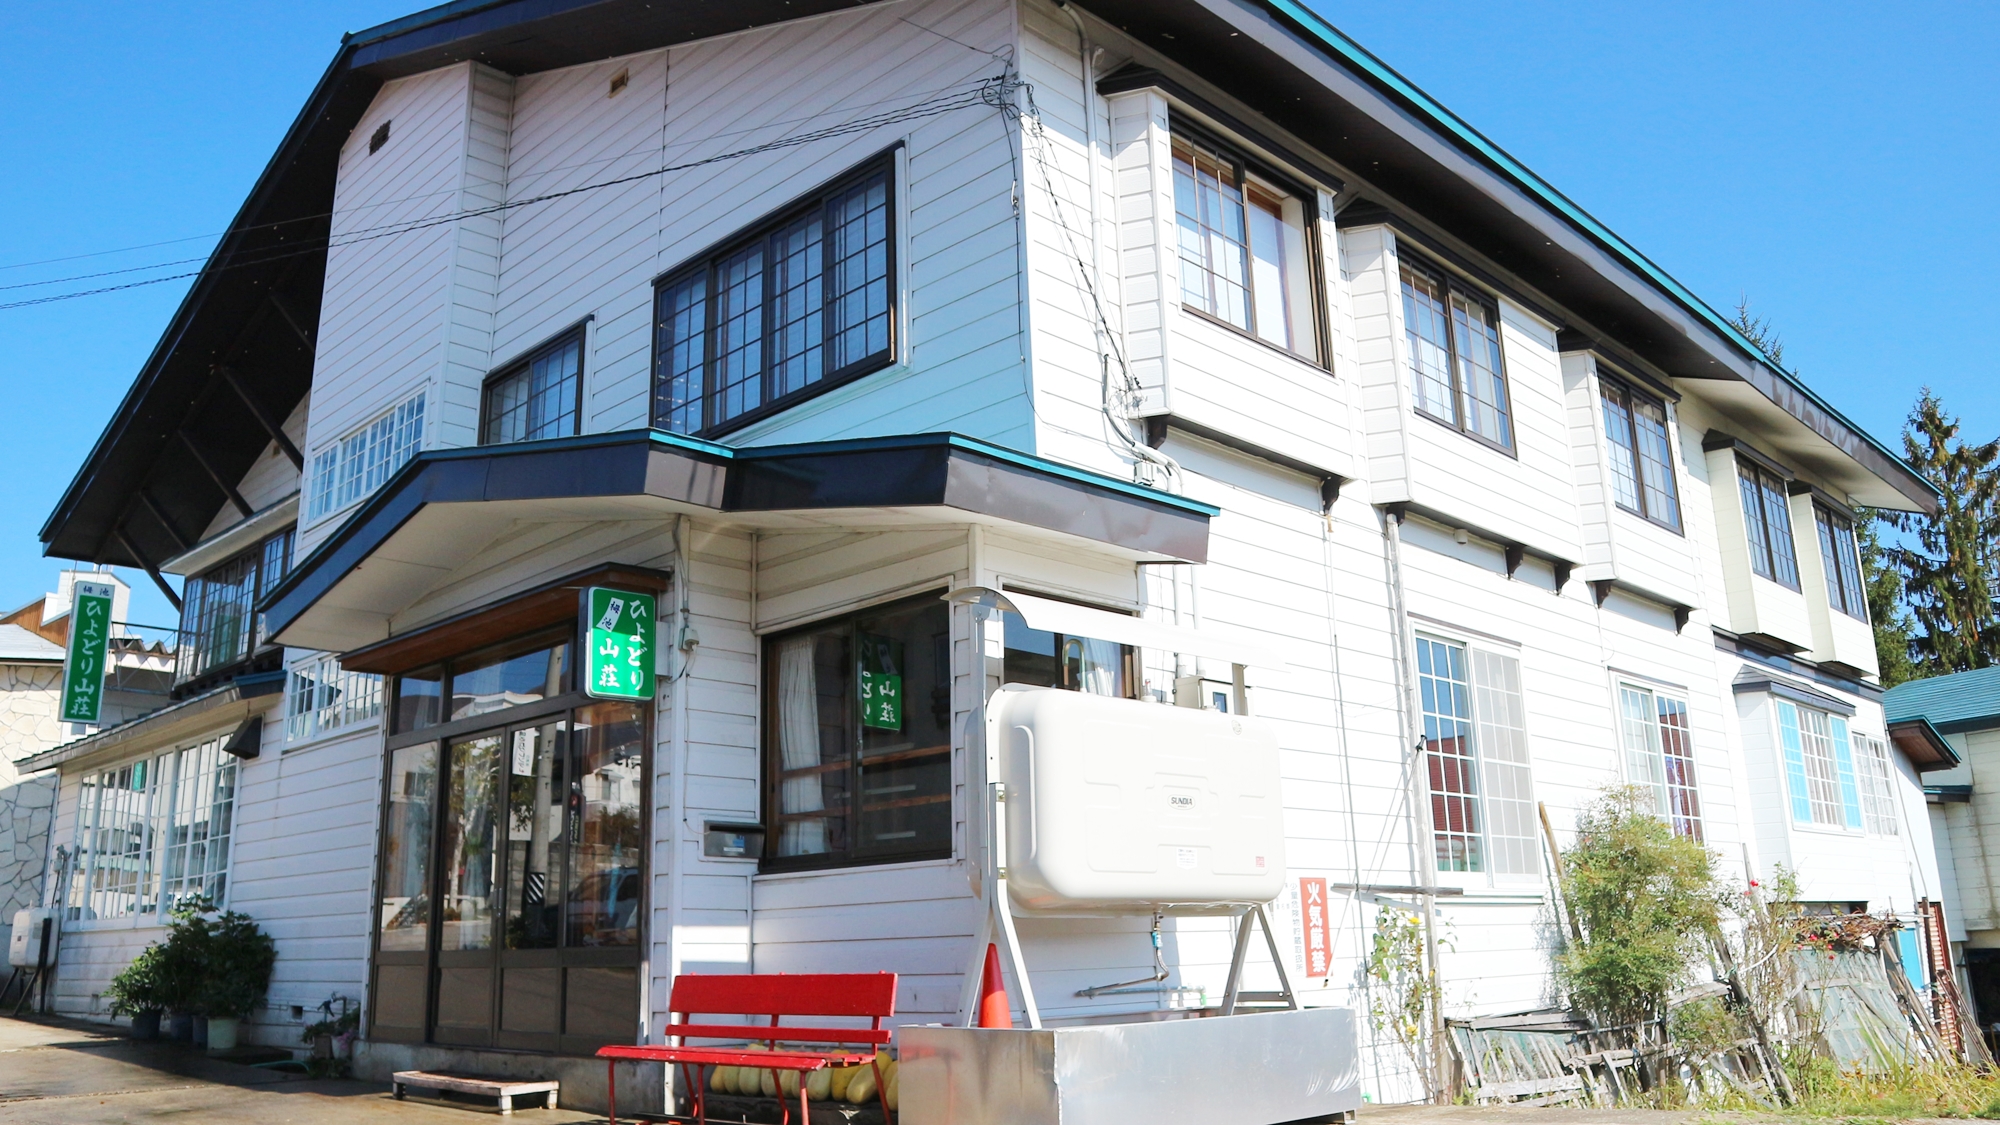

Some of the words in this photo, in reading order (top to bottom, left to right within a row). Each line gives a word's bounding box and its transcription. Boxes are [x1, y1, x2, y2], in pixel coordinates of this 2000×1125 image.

[70, 600, 102, 716] ひよどり山荘
[598, 637, 621, 688] 山荘
[626, 599, 648, 691] ひよどり
[1306, 881, 1326, 973] 火気厳禁
